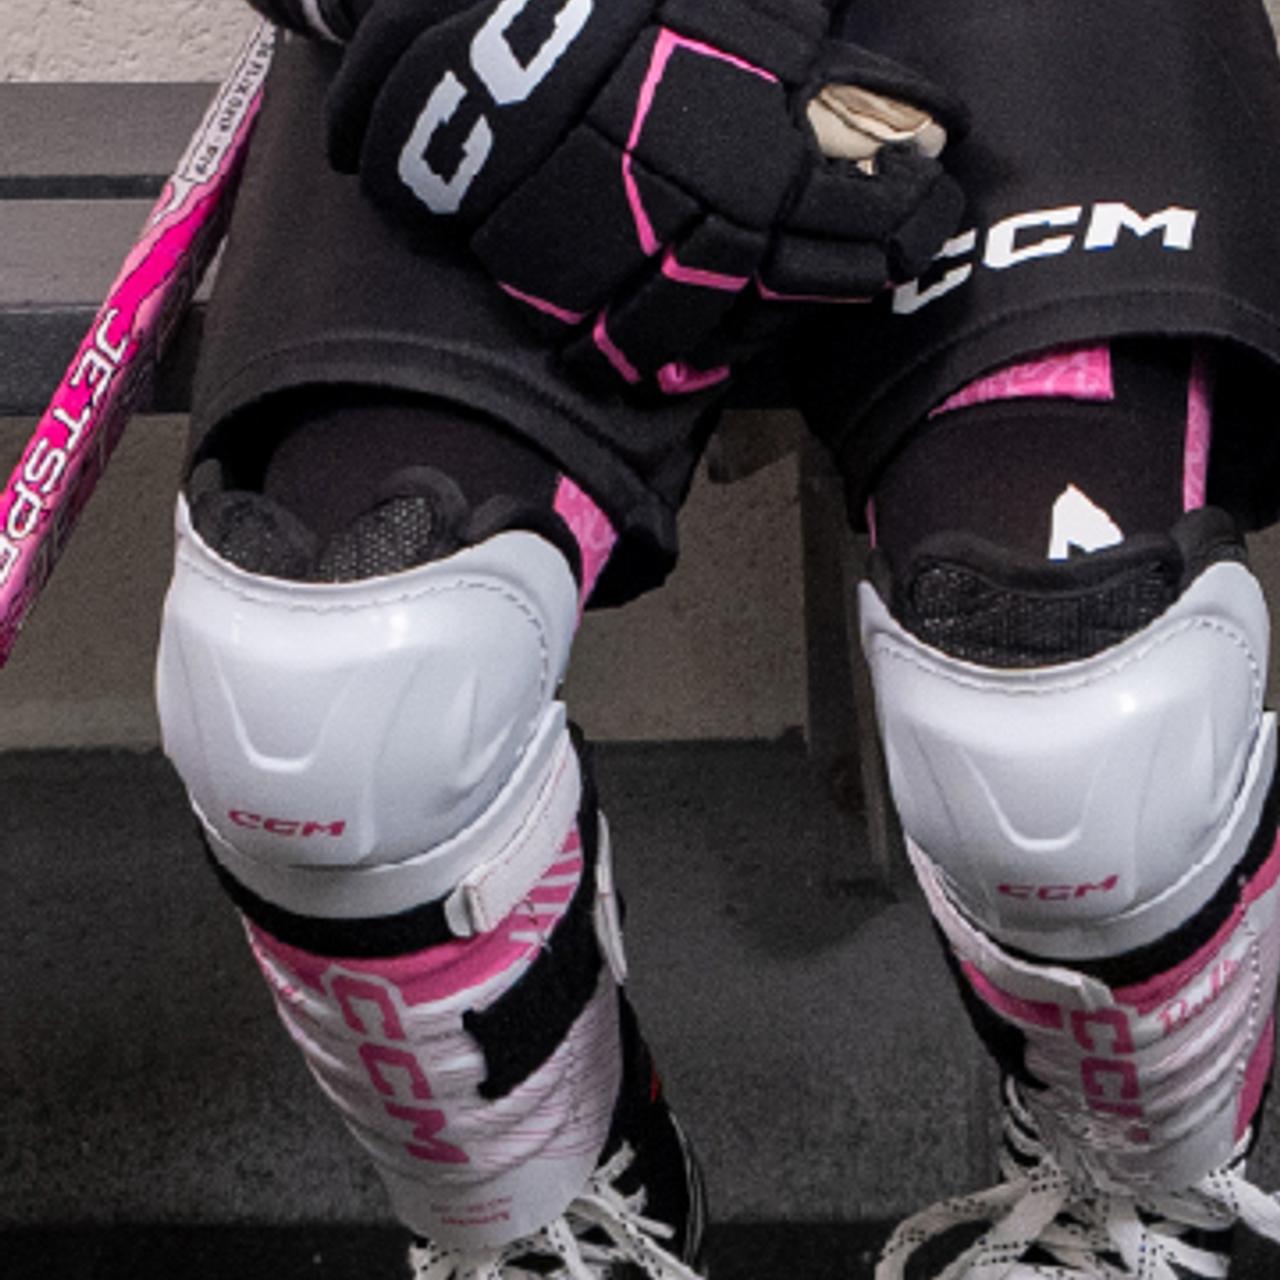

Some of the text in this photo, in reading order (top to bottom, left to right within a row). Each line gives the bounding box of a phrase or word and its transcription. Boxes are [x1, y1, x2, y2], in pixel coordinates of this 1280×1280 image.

[226, 808, 347, 839] CCM
[996, 874, 1120, 903] CCM
[328, 971, 470, 1166] CCM
[1069, 1005, 1150, 1142] CC
